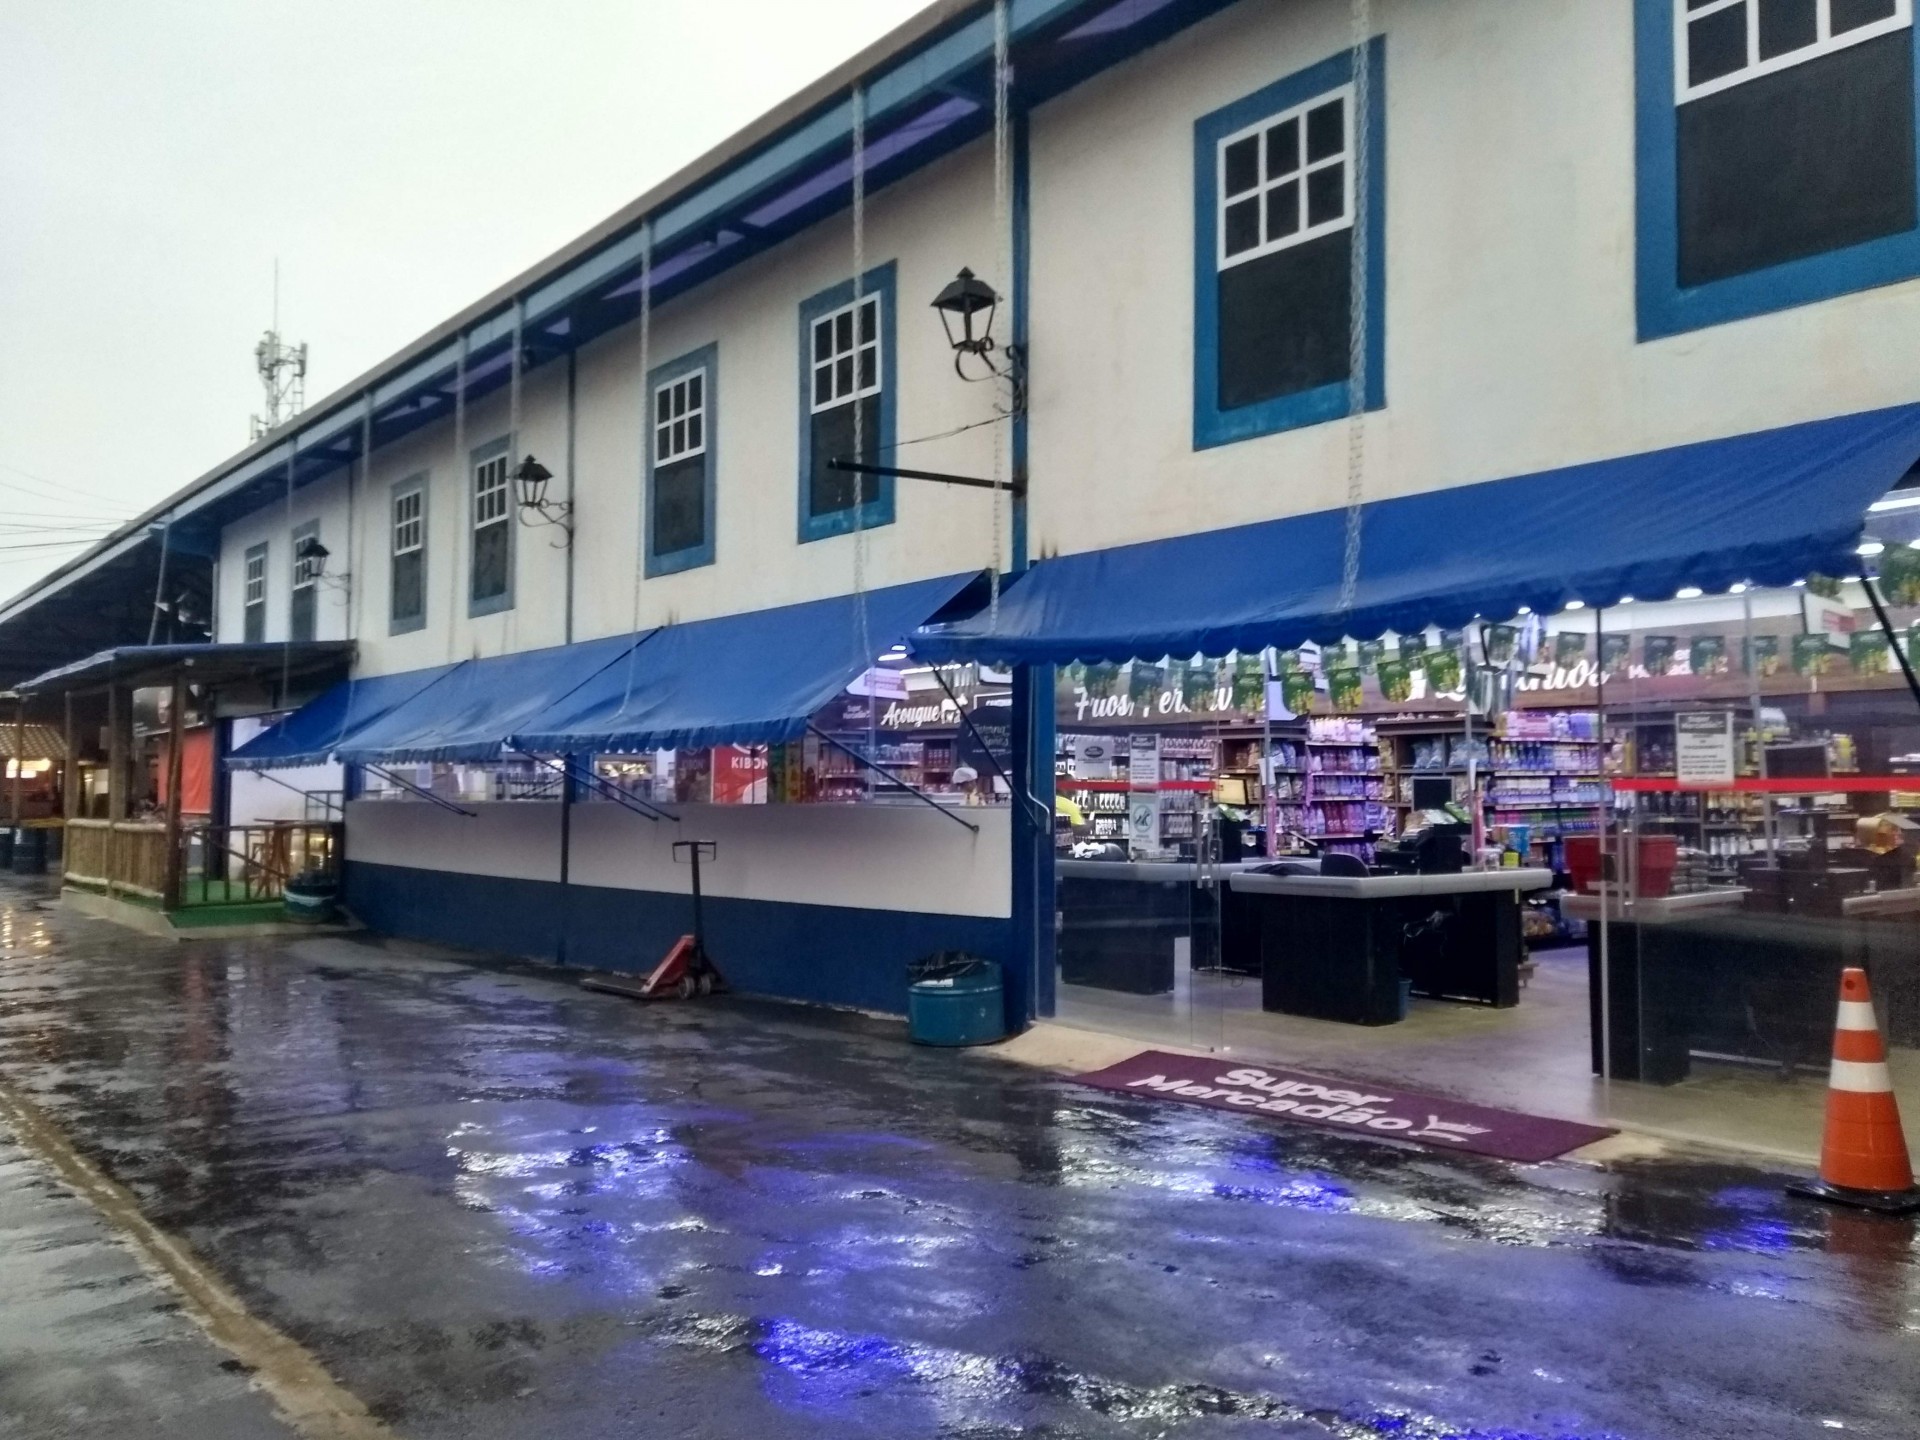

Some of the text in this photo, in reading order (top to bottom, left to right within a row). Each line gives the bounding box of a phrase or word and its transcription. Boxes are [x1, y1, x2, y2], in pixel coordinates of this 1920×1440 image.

[880, 701, 940, 729] Açougue
[1127, 1074, 1413, 1131] Mercadão
[1215, 1068, 1393, 1107] Super
